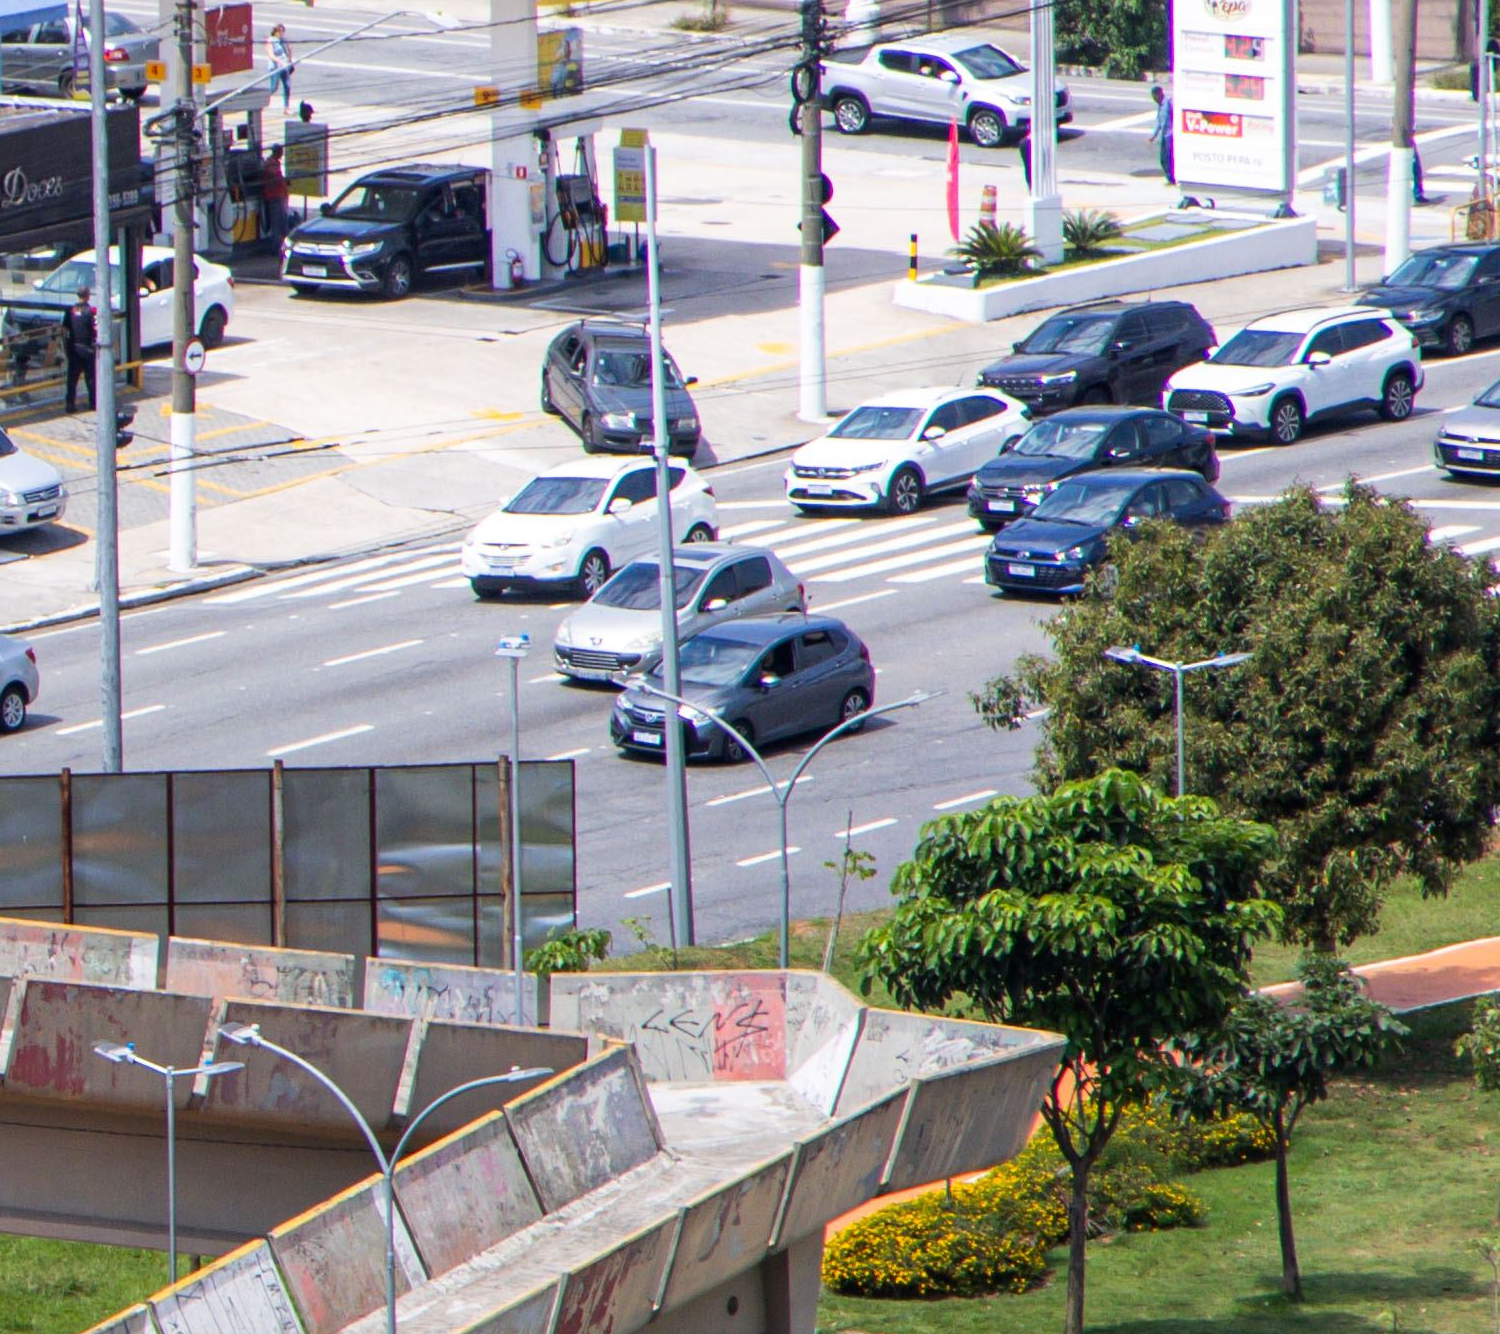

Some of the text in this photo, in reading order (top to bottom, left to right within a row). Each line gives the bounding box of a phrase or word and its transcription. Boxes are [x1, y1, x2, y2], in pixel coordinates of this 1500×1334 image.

[1186, 119, 1238, 136] V-Power
[1192, 152, 1225, 164] POSTO
[2, 167, 63, 206] Doces
